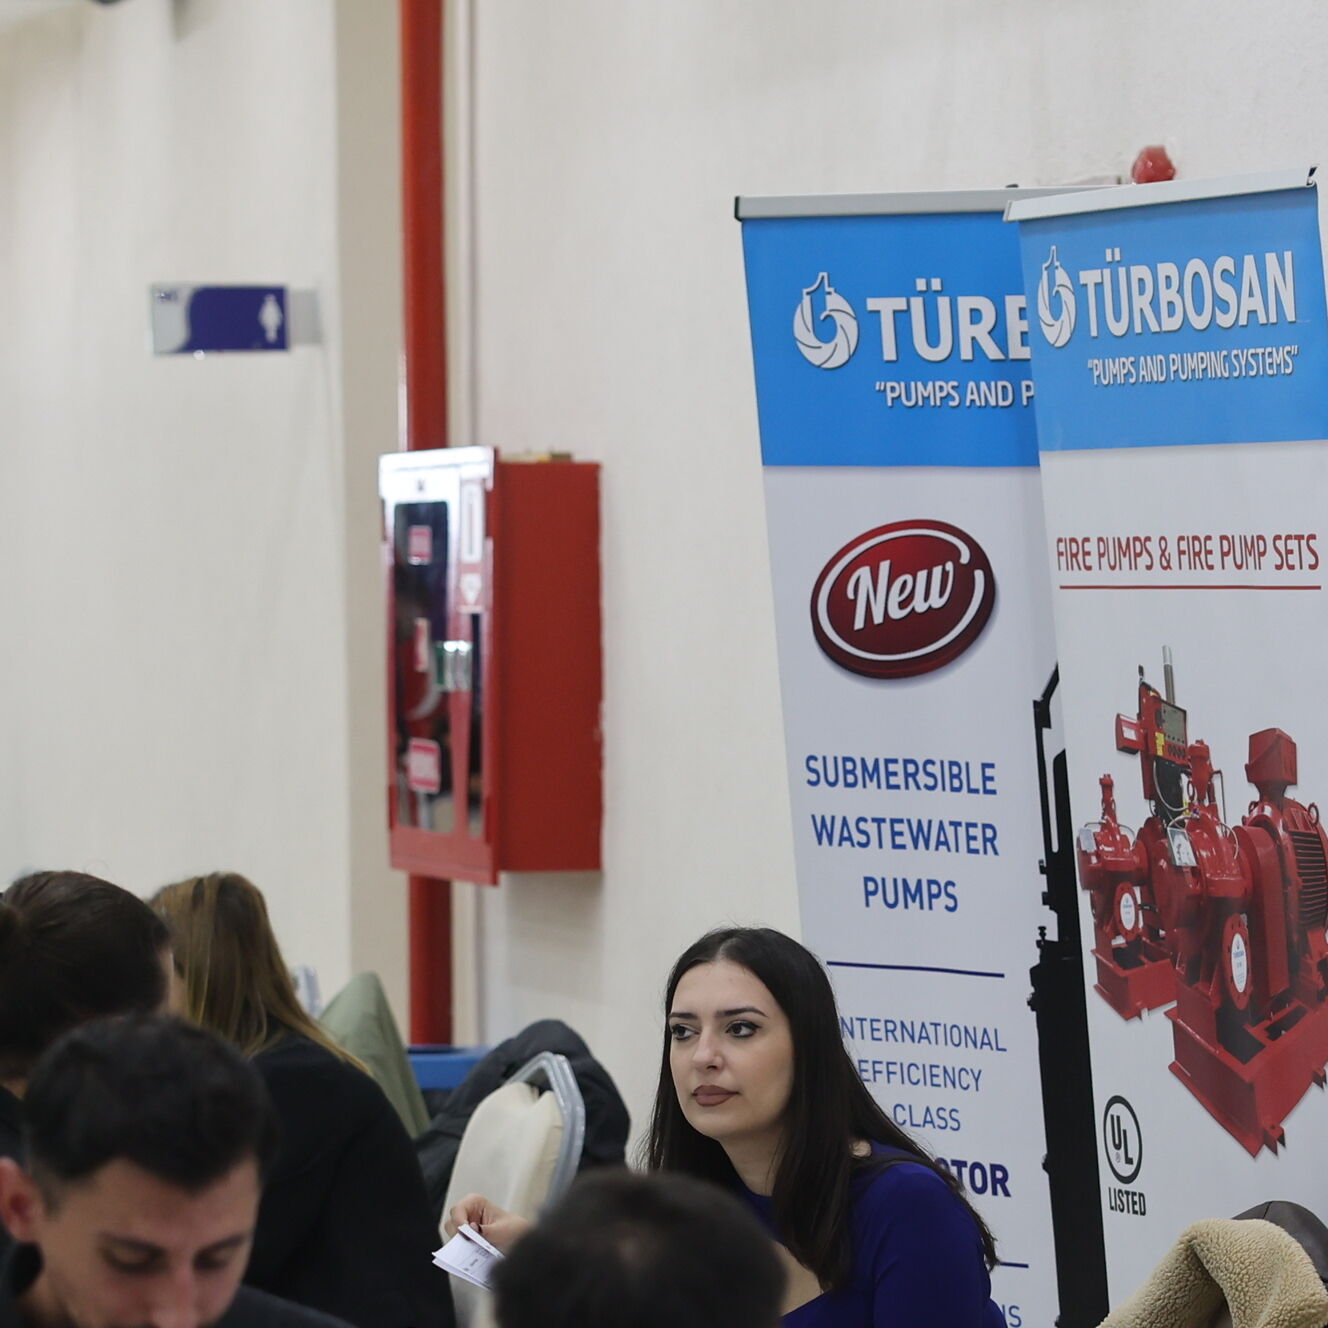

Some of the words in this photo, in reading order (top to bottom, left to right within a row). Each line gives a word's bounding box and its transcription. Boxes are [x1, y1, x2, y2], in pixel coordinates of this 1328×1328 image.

[1080, 248, 1297, 338] TÜRBOSAN
[1139, 353, 1168, 384] AND
[1170, 349, 1230, 381] PUMPING
[965, 380, 1015, 408] AND
[1056, 536, 1093, 572] FIRE
[1096, 536, 1155, 572] PUMPS
[1158, 535, 1173, 572] &
[1176, 534, 1215, 571] FIRE
[1219, 534, 1268, 571] PUMP
[1272, 533, 1320, 571] SETS
[846, 558, 955, 632] New
[805, 754, 999, 796] SUBMERSIBLE
[810, 813, 1000, 857] WASTEWATER
[862, 876, 960, 913] PUMPS
[839, 1015, 1008, 1052] NTERNATIONAL
[857, 1058, 983, 1093] EFFICIENCY
[892, 1103, 962, 1132] CLASS
[1110, 1113, 1134, 1166] UL
[1107, 1185, 1147, 1217] LISTED
